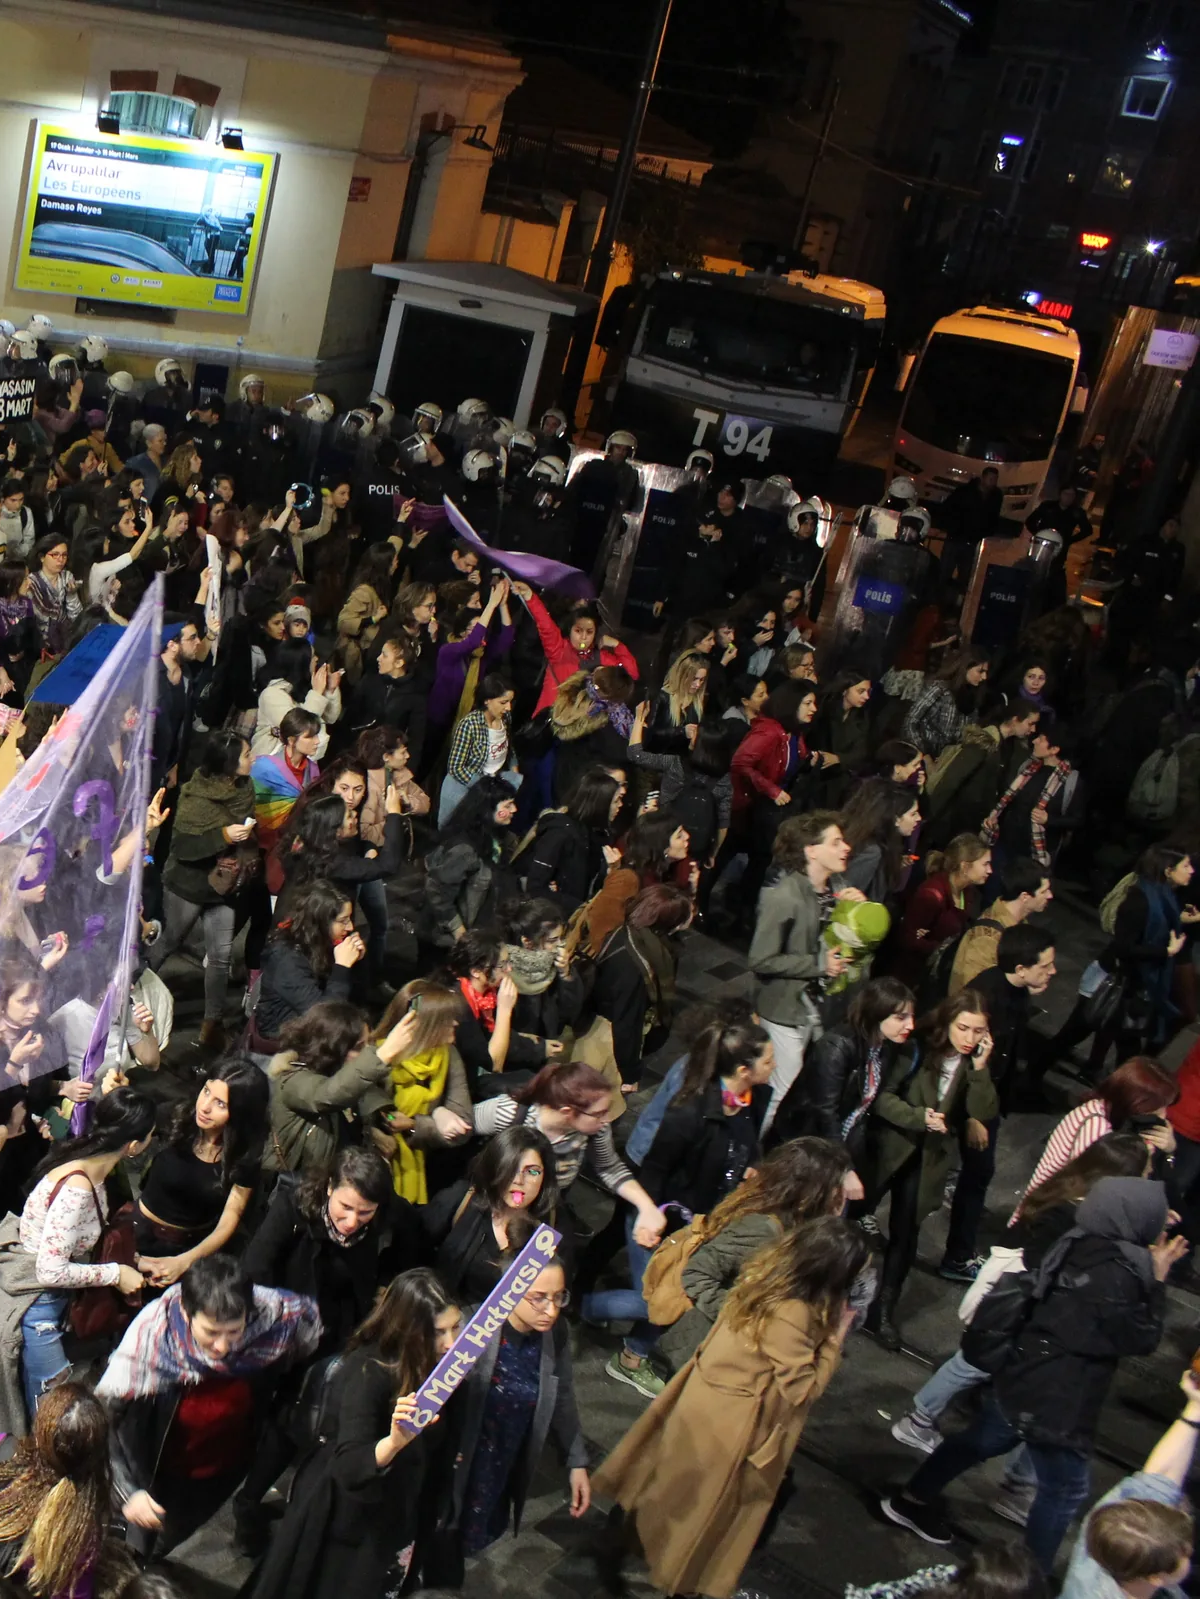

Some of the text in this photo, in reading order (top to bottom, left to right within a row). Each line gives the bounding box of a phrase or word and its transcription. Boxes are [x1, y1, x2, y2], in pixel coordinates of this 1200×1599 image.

[43, 176, 67, 192] Les
[40, 198, 103, 215] Damaso Reyes
[6, 396, 33, 418] MART
[692, 407, 774, 463] T 94
[423, 1350, 477, 1406] Mart
[464, 1257, 543, 1349] Hatırası
